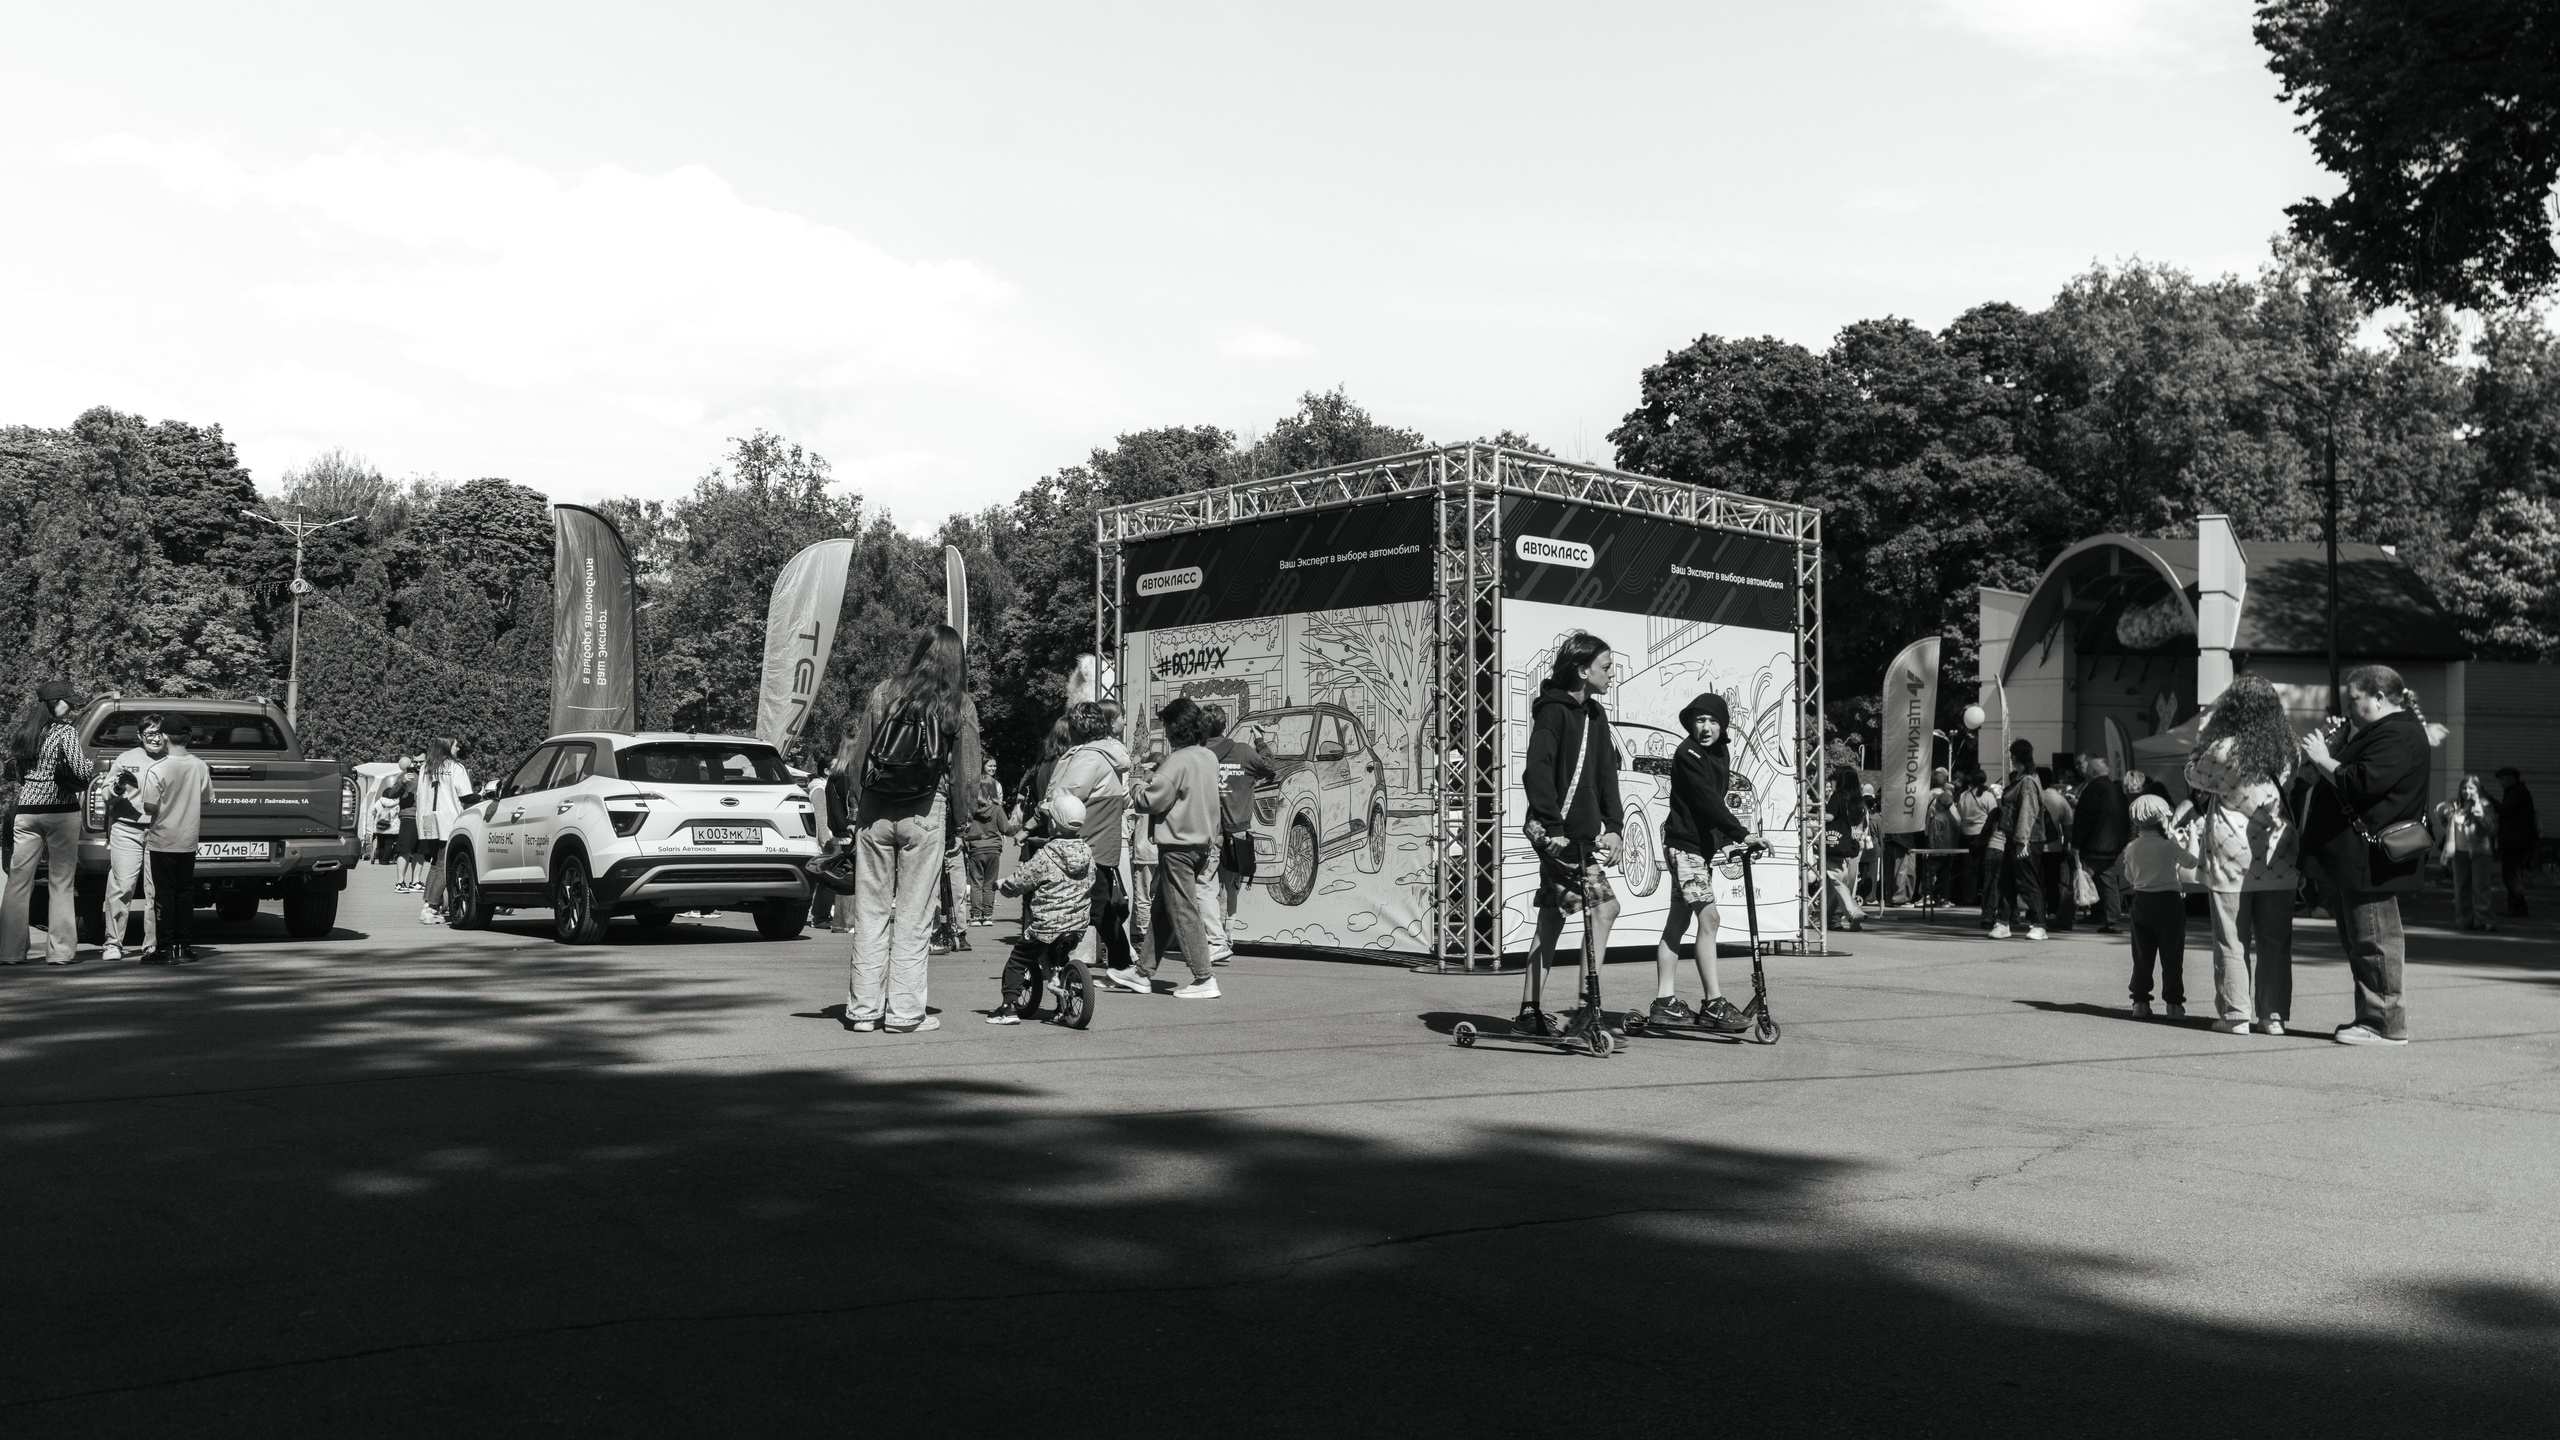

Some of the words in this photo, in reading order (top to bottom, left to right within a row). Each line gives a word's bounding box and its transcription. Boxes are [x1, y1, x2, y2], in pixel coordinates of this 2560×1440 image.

[1279, 559, 1296, 570] Ваш
[1297, 555, 1329, 569] Эксперт
[1330, 555, 1336, 563] в
[1337, 549, 1368, 563] выборе
[1369, 543, 1420, 558] автомобиля
[1522, 540, 1588, 562] АВТОКЛАСС
[1141, 571, 1197, 591] АВТОКЛАСС
[1671, 564, 1686, 576] Ваш
[1686, 565, 1715, 581] Эксперт
[1715, 572, 1720, 580] в
[1720, 572, 1746, 585] выборе
[1746, 577, 1784, 590] автомобиля
[1157, 645, 1230, 678] #ВОЗДУХ
[781, 621, 821, 757] TEN
[1903, 699, 1921, 818] ЩЕКИНОАЗОТ
[488, 832, 505, 844] Solaris
[698, 828, 744, 840] К003МК
[746, 828, 758, 837] 71
[252, 843, 264, 852] 71
